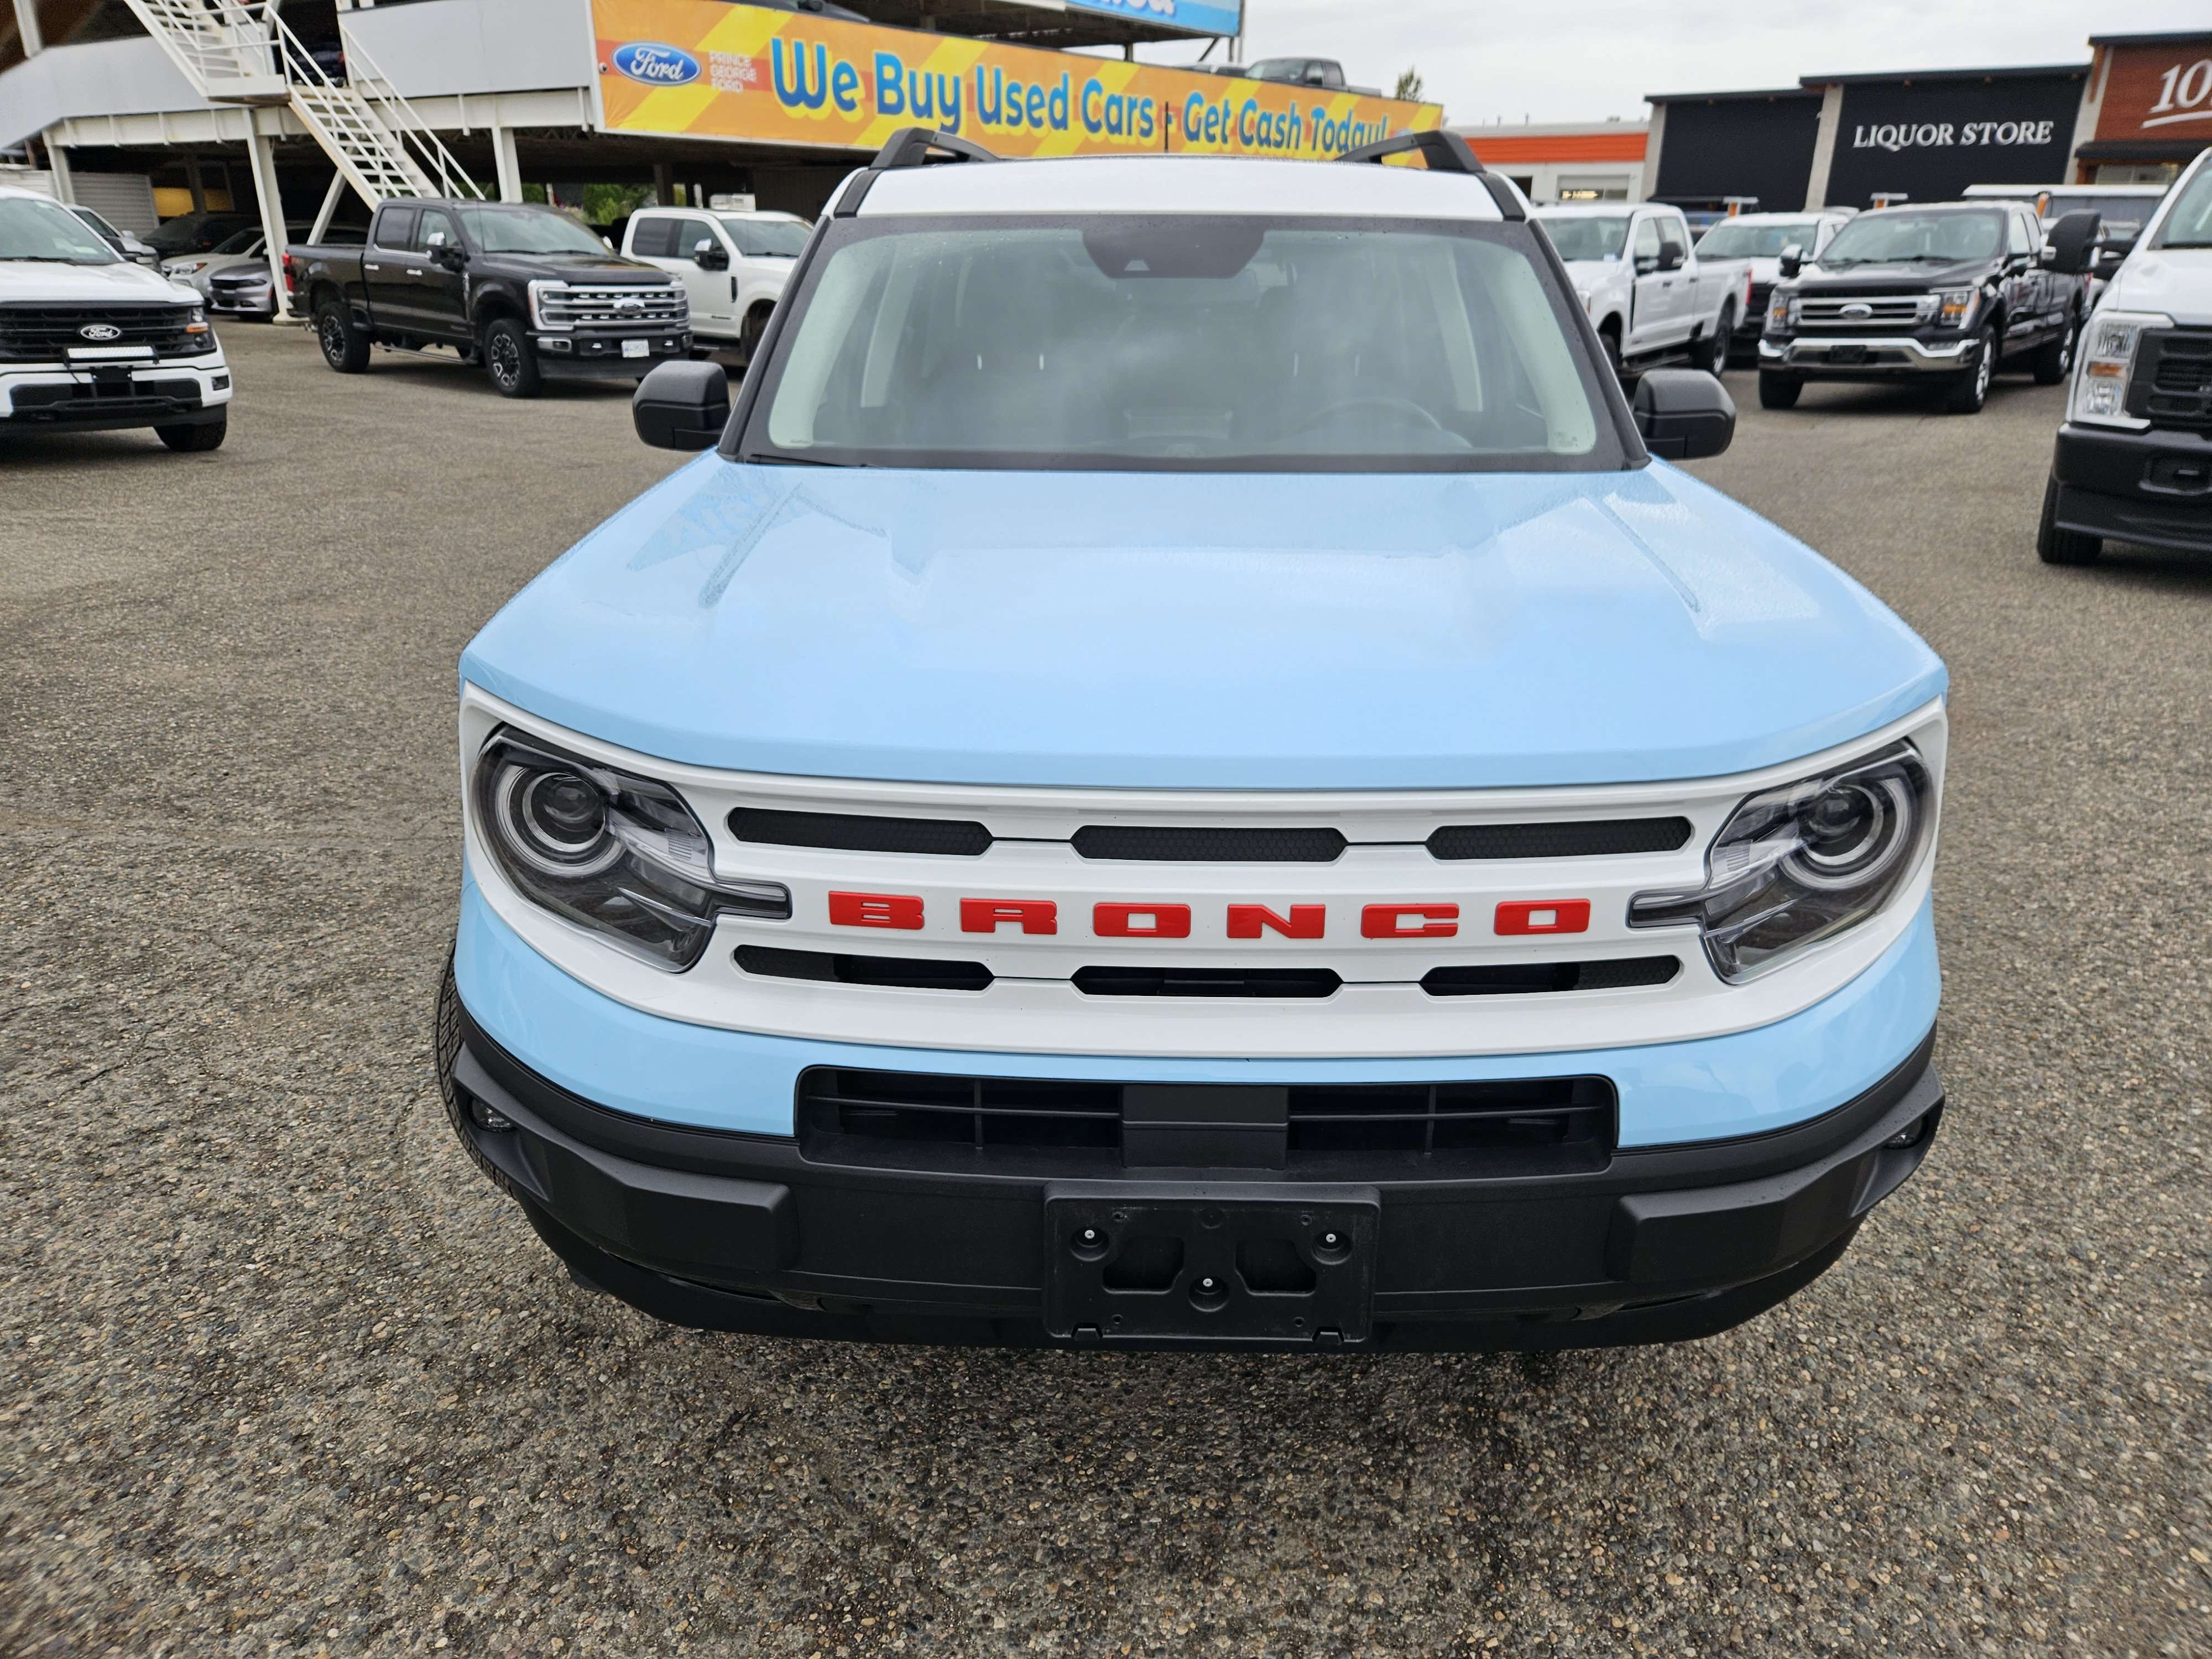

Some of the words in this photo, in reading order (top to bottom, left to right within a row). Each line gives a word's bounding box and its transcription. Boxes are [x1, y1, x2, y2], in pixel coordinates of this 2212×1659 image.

[630, 47, 685, 80] Ford
[708, 50, 751, 67] PRINCE
[710, 65, 757, 82] GEORGE
[711, 78, 743, 93] FORD
[771, 38, 859, 112] We
[874, 51, 961, 135] Buy
[975, 65, 1069, 131] Used
[1082, 78, 1154, 138] Cars
[1183, 92, 1231, 145] Get
[1239, 98, 1302, 150] Cash
[2150, 59, 2212, 114] 10
[1853, 123, 1954, 152] LIQUOR
[1959, 121, 2054, 146] STORE
[828, 890, 1592, 939] BRONCO
